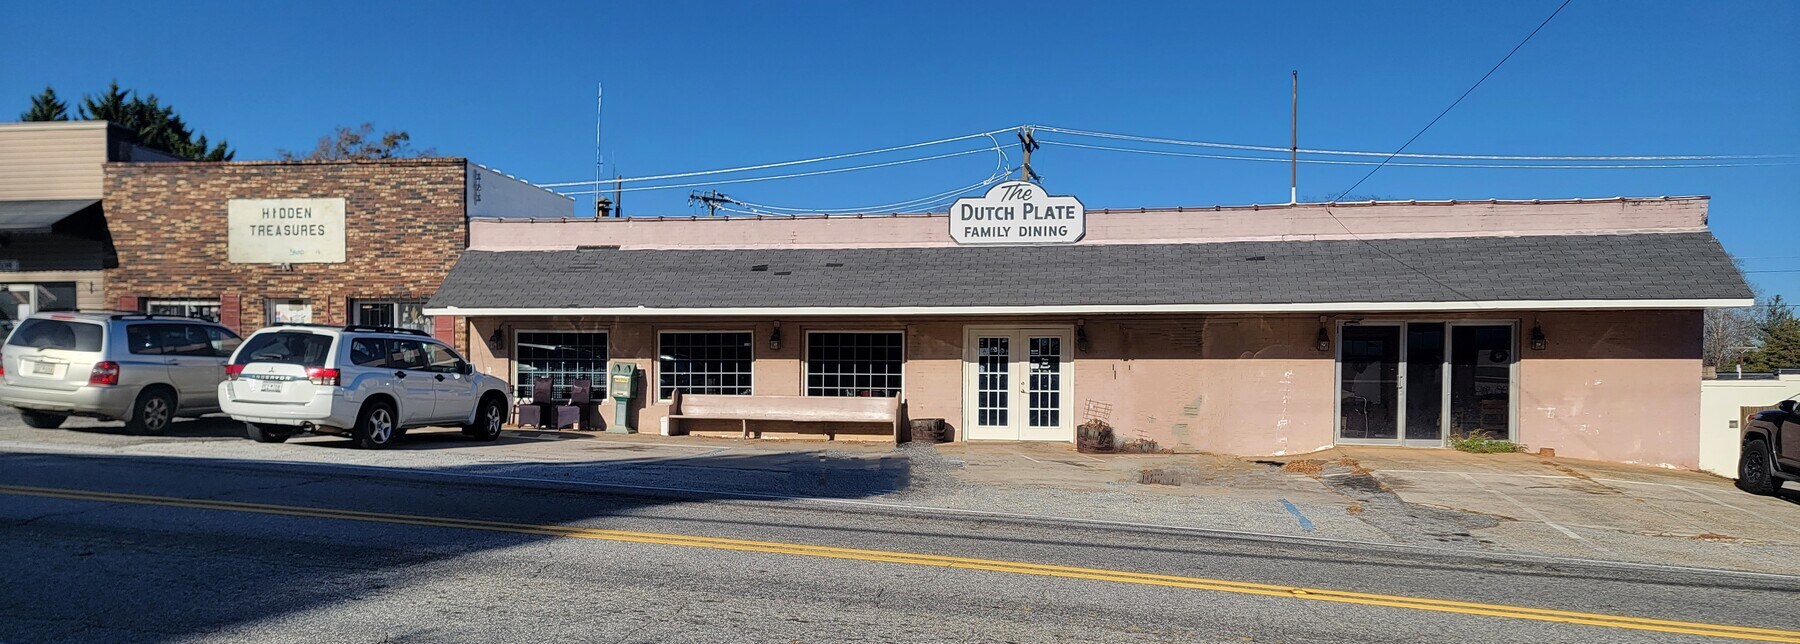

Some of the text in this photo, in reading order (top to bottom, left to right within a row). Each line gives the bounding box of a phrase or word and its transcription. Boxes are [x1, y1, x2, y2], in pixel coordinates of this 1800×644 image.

[1001, 183, 1033, 202] The
[262, 208, 312, 219] HIDDEN
[961, 203, 1076, 221] DUTCH PLATE
[250, 224, 325, 236] TREASURES
[964, 226, 1068, 238] FAMILY DINING
